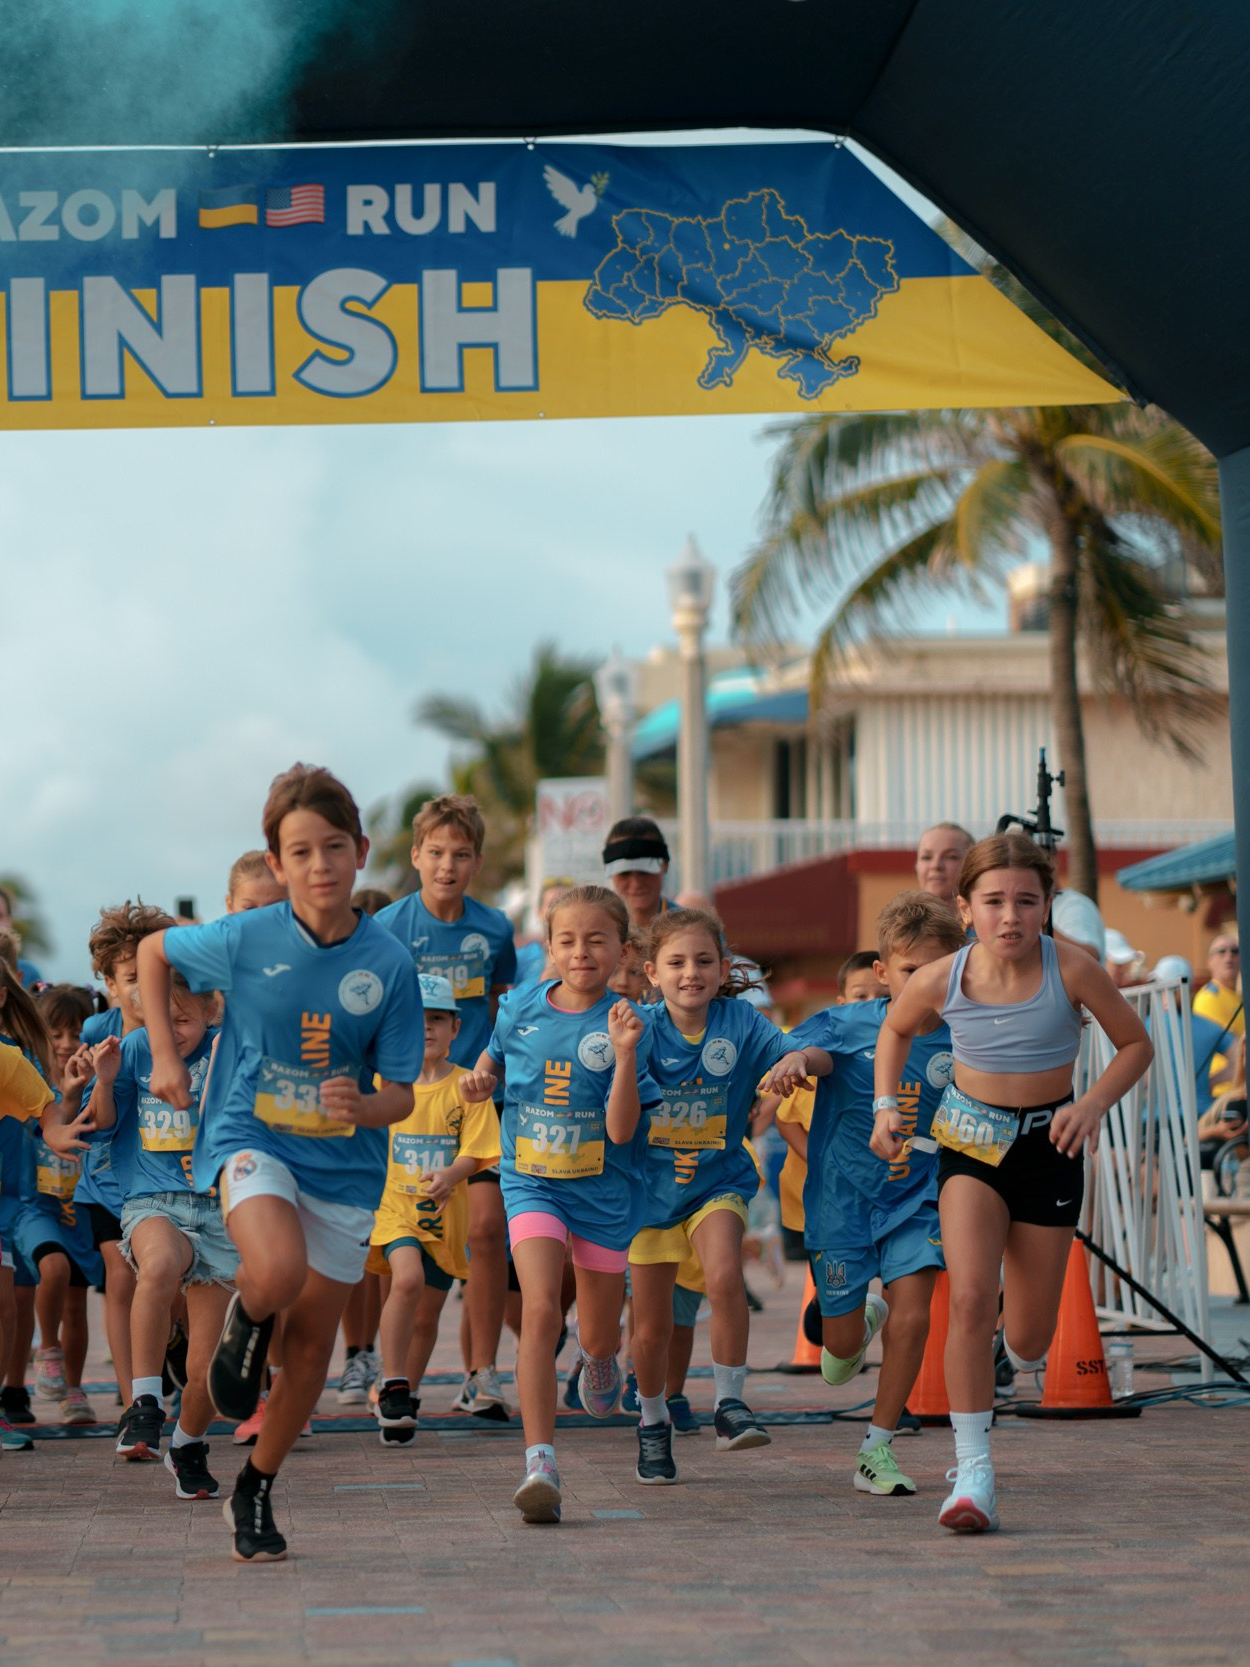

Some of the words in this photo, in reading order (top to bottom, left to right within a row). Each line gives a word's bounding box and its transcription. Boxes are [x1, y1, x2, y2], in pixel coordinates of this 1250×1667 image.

[346, 181, 496, 236] RUN
[271, 1062, 309, 1078] RAZOM
[274, 1079, 332, 1115] 33
[700, 1087, 718, 1095] RUN
[144, 1110, 191, 1139] 329
[525, 1106, 554, 1118] RAZOM
[654, 1101, 707, 1128] 326
[989, 1111, 1010, 1123] RUN
[532, 1122, 581, 1155] 327
[948, 1108, 994, 1150] 160
[404, 1149, 445, 1175] 314
